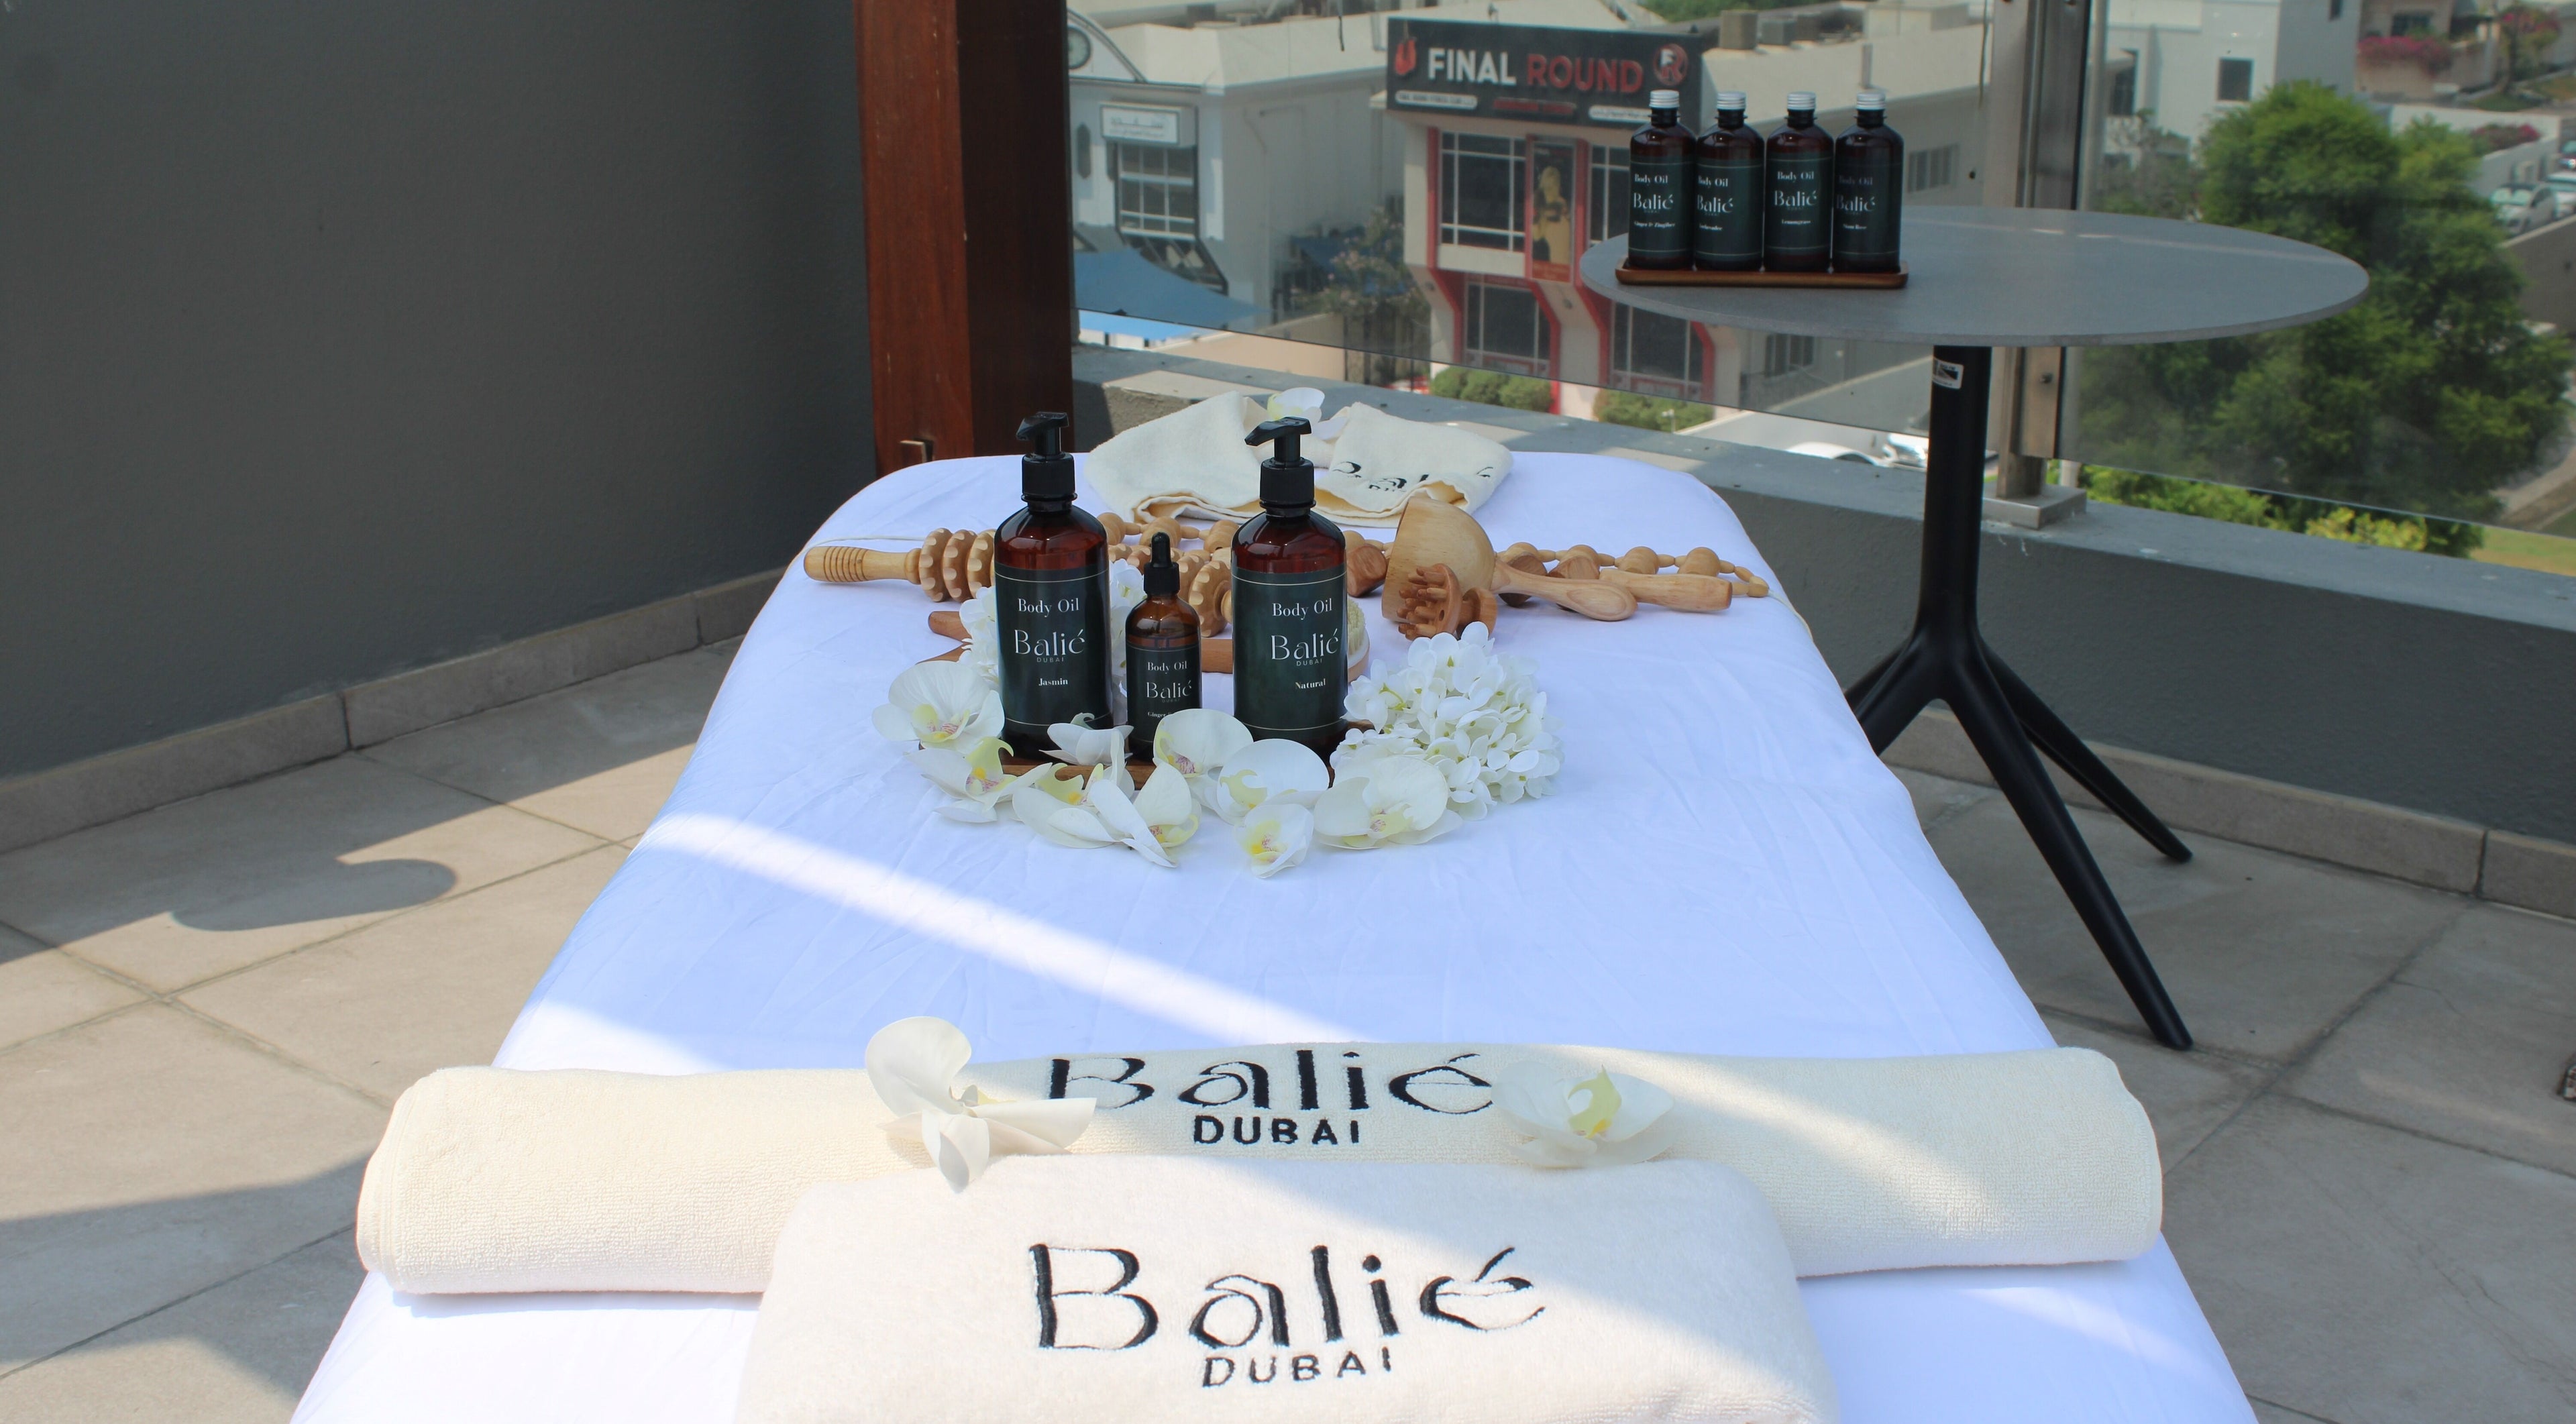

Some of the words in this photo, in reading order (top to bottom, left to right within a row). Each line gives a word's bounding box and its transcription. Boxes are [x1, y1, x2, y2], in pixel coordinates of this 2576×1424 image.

[1428, 48, 1517, 85] FINAL
[1527, 54, 1643, 93] ROUND
[1635, 174, 1651, 186] Body
[1654, 174, 1668, 183] Oil
[1698, 175, 1711, 188] Body
[1715, 178, 1728, 187] Oil
[1777, 171, 1796, 182] Body
[1801, 170, 1815, 180] Oil
[1859, 176, 1873, 185] Oil
[1018, 598, 1052, 617] Body
[1058, 598, 1079, 612] Oil
[1273, 602, 1309, 620] Body
[1313, 598, 1332, 614] Oil
[1014, 628, 1085, 656] Balié
[1271, 628, 1339, 660] Balié
[1147, 661, 1170, 675] Body
[1174, 660, 1187, 670] Oil
[1296, 658, 1323, 667] DUBAI
[1038, 678, 1068, 686] Jasmin
[1146, 679, 1192, 698] Balié
[1295, 678, 1326, 690] Natural
[1049, 1049, 1493, 1113] Balié
[1193, 1115, 1360, 1145] DUBAI
[1029, 1244, 1546, 1350] Balié
[1202, 1346, 1391, 1388] DUBAI
